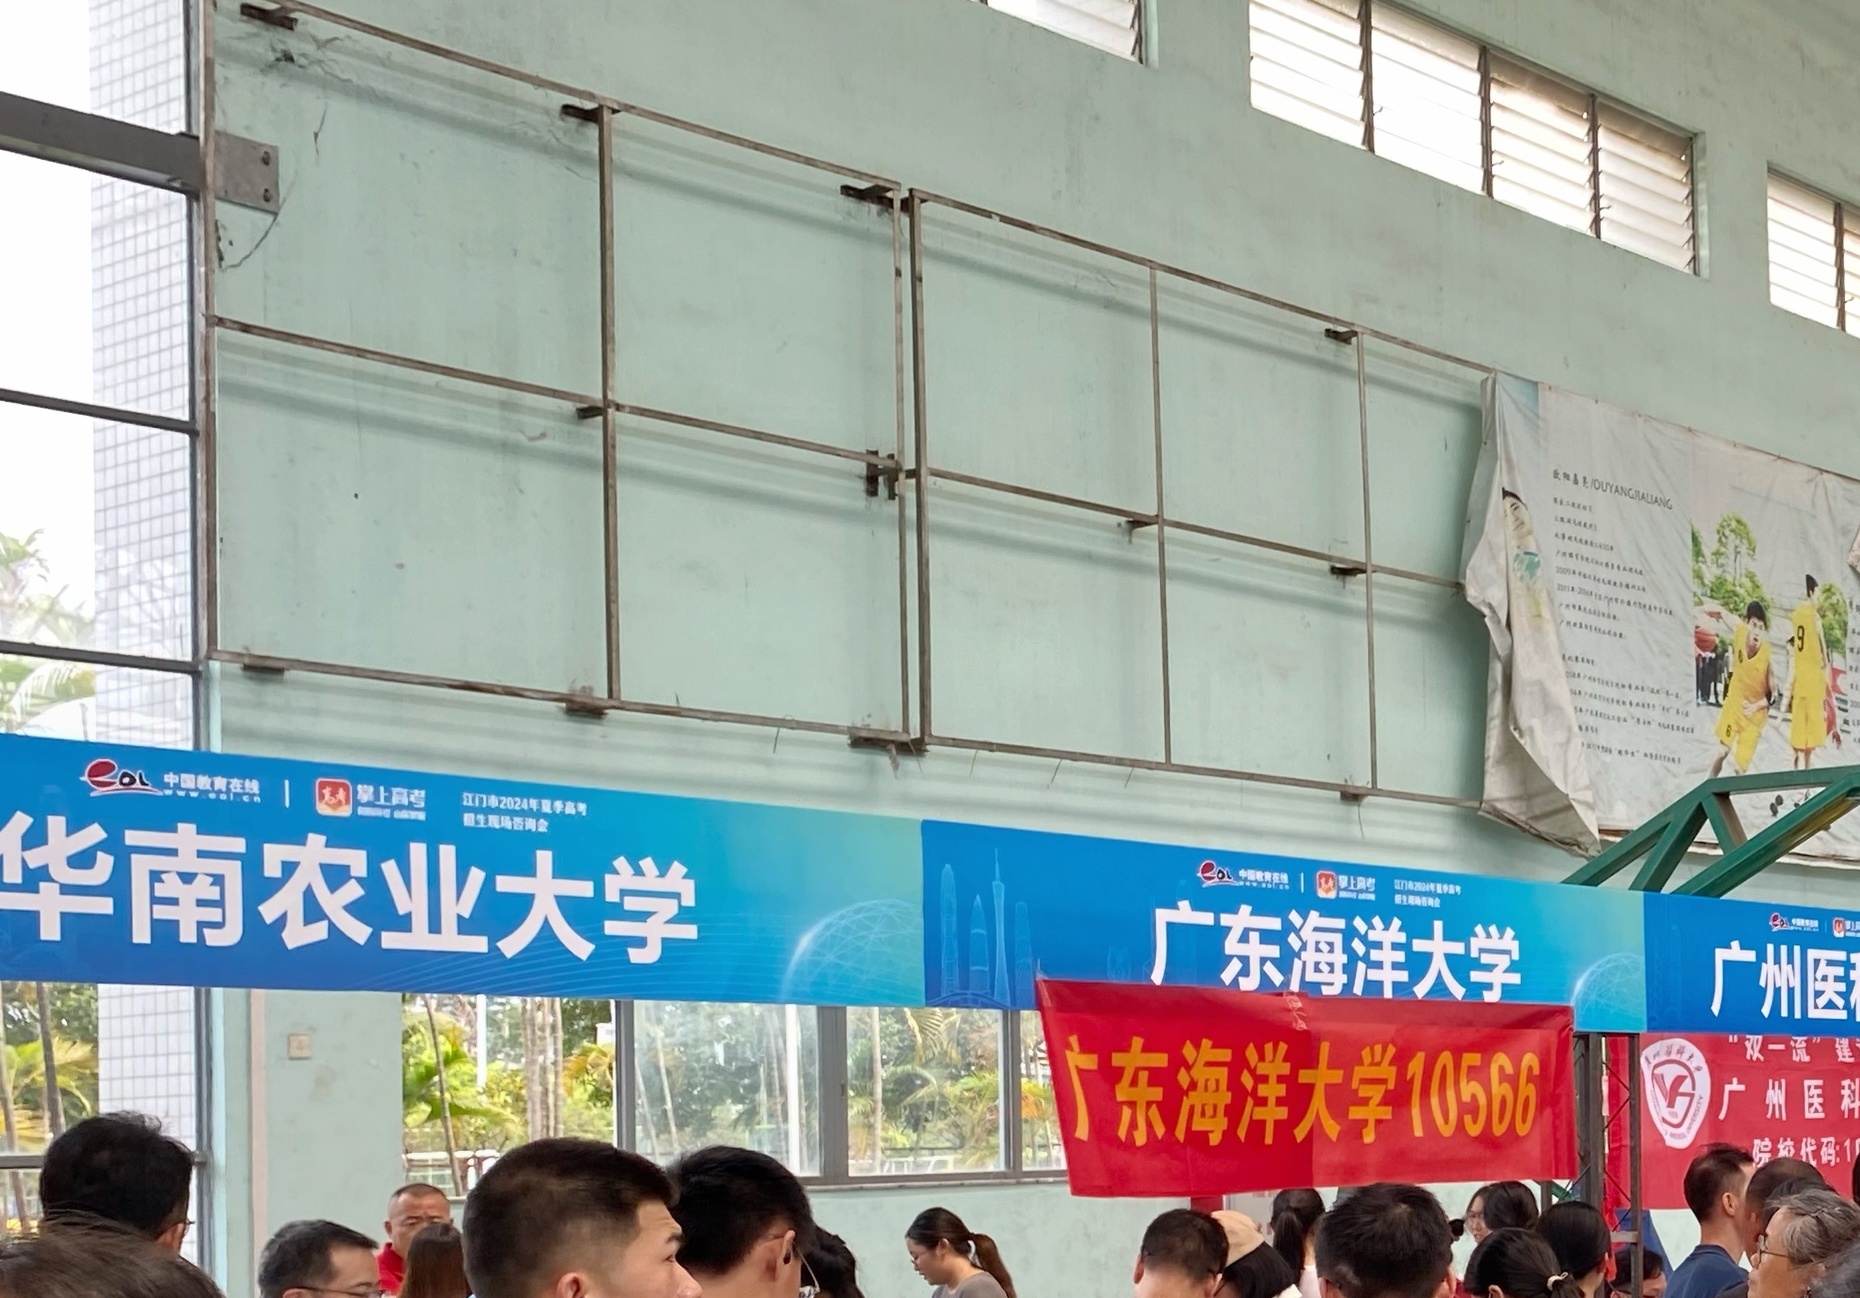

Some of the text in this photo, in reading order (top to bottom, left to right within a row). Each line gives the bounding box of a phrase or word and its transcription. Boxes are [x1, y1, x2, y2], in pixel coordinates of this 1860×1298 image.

[163, 772, 260, 794] 中国教育在线
[356, 784, 426, 808] 掌上高考
[462, 791, 587, 816] 江门市2024年夏季高考
[462, 812, 549, 833] 招生现场咨询会
[0, 812, 700, 964] 华南农业大学
[1338, 875, 1376, 892] 掌上高考
[1151, 901, 1521, 1002] 广东海洋大学
[1064, 1034, 1541, 1148] 广东海洋大学10566
